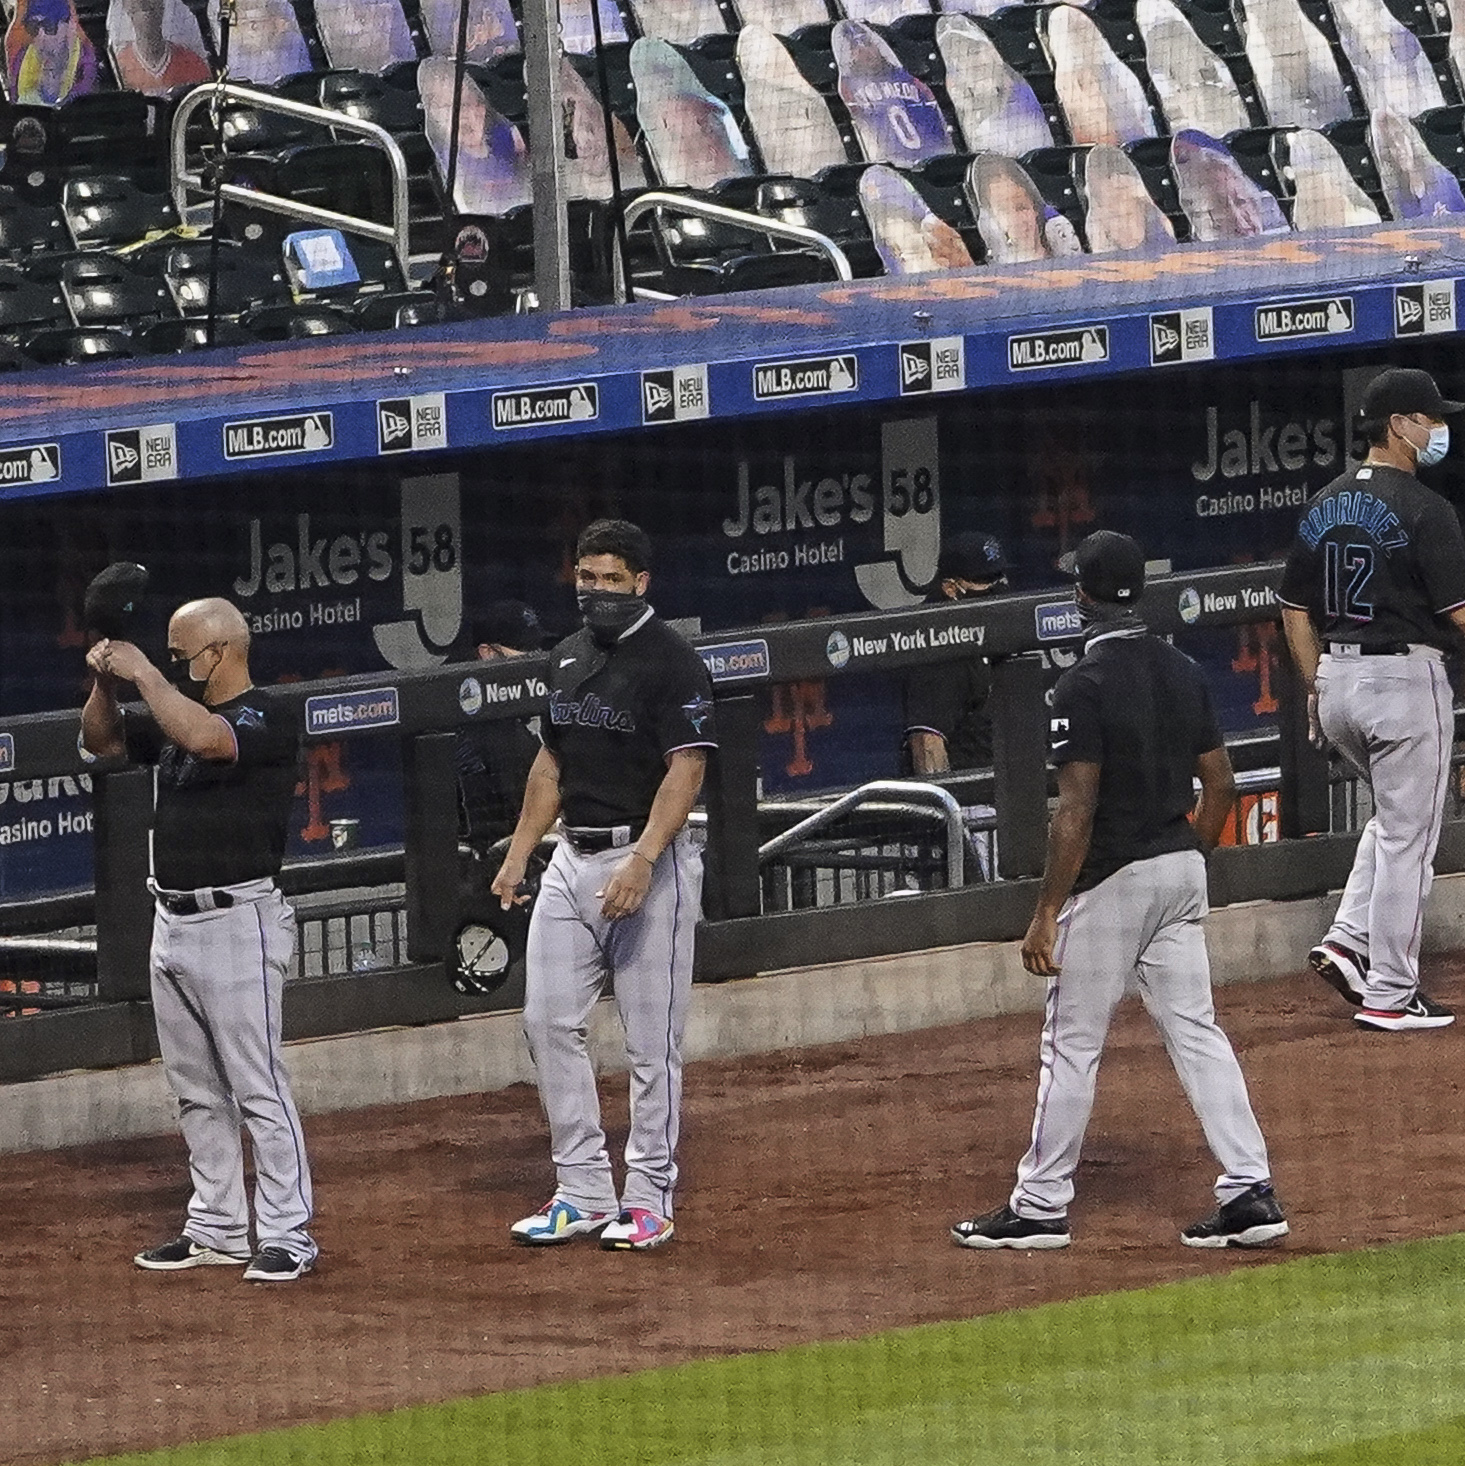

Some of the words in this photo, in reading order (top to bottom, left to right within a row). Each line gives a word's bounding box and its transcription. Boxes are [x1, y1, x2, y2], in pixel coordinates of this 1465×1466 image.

[1428, 292, 1450, 306] NEW
[1185, 319, 1208, 334] NEW
[1259, 309, 1326, 336] MLB.com
[1429, 307, 1451, 322] ERA
[1012, 338, 1080, 365] MLB.com
[1186, 334, 1209, 350] ERA
[935, 349, 958, 363] NEW
[678, 377, 701, 391] NEW
[758, 368, 827, 394] MLB.com
[936, 364, 959, 379] ERA
[497, 398, 568, 423] MLB.com
[679, 392, 702, 408] ERA
[416, 406, 440, 421] NEW
[145, 435, 171, 451] NEW
[229, 427, 302, 453] MLB.com
[417, 422, 441, 438] ERA
[1191, 400, 1338, 481] Jake's
[146, 451, 172, 468] ERA
[722, 455, 875, 537] Jake's
[889, 467, 935, 518] 58
[1196, 491, 1254, 516] Casino
[1260, 482, 1308, 510] Hotel
[233, 513, 393, 596] Jake's
[408, 524, 456, 575] 58
[727, 547, 789, 575] Casino
[794, 537, 844, 567] Hotel
[1326, 542, 1375, 622] 12
[310, 598, 361, 626] Hotel
[1204, 593, 1237, 612] New
[1240, 586, 1276, 608] York
[1042, 610, 1081, 632] mets
[853, 637, 886, 657] New
[890, 631, 926, 653] York
[930, 625, 985, 648] Lottery
[704, 652, 765, 674] ts.com
[486, 683, 520, 703] New
[525, 677, 547, 698] Yo
[312, 699, 393, 727] mets.com
[0, 817, 52, 845] asino
[58, 810, 94, 836] Hot
